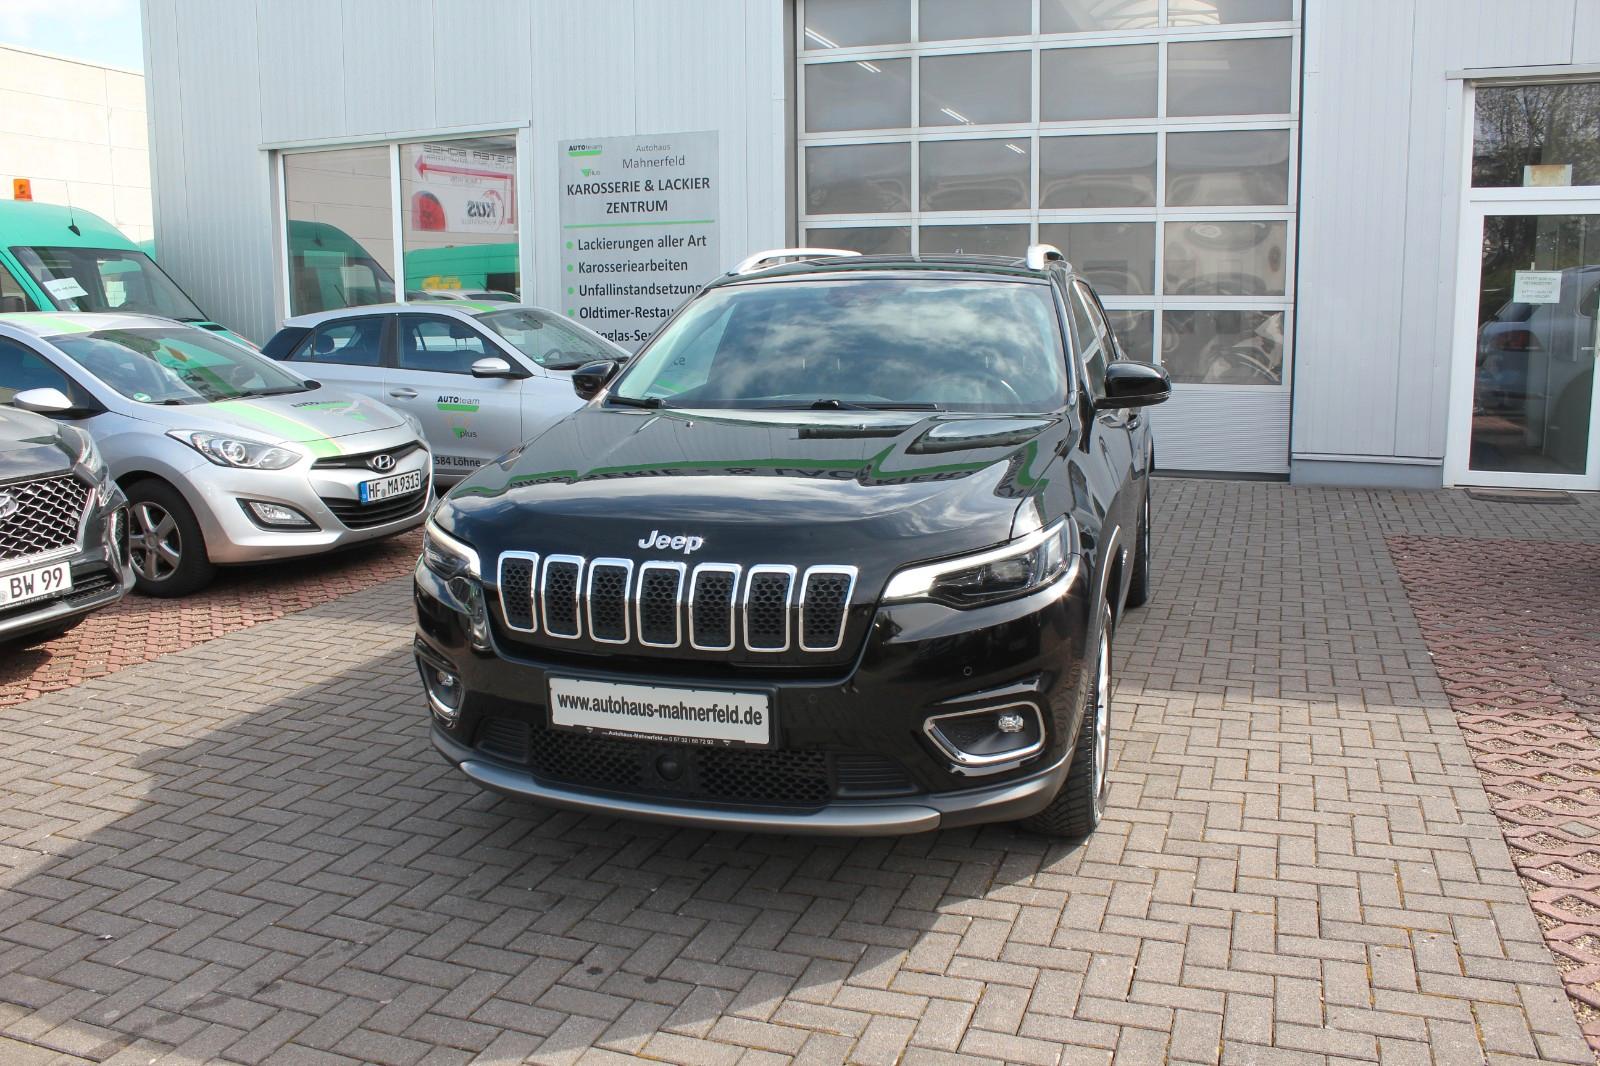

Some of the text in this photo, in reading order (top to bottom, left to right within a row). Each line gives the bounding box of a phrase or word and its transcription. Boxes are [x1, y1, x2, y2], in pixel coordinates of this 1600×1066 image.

[636, 143, 671, 152] Autohaus
[622, 155, 686, 169] Mahnerfeld
[567, 177, 711, 196] KAROSSERIE & LACKIER
[606, 199, 668, 214] ZENTRUM
[578, 234, 707, 252] Lackierungen aller Art
[578, 260, 688, 274] Karosseriearbeiten
[437, 395, 480, 405] AUTOteam
[460, 430, 478, 439] plus
[453, 456, 481, 467] Löhne
[368, 482, 381, 499] HF
[638, 530, 704, 554] Jeep
[10, 567, 63, 598] BW 99
[557, 693, 763, 726] www.autohaus-mahnerfeld.de
